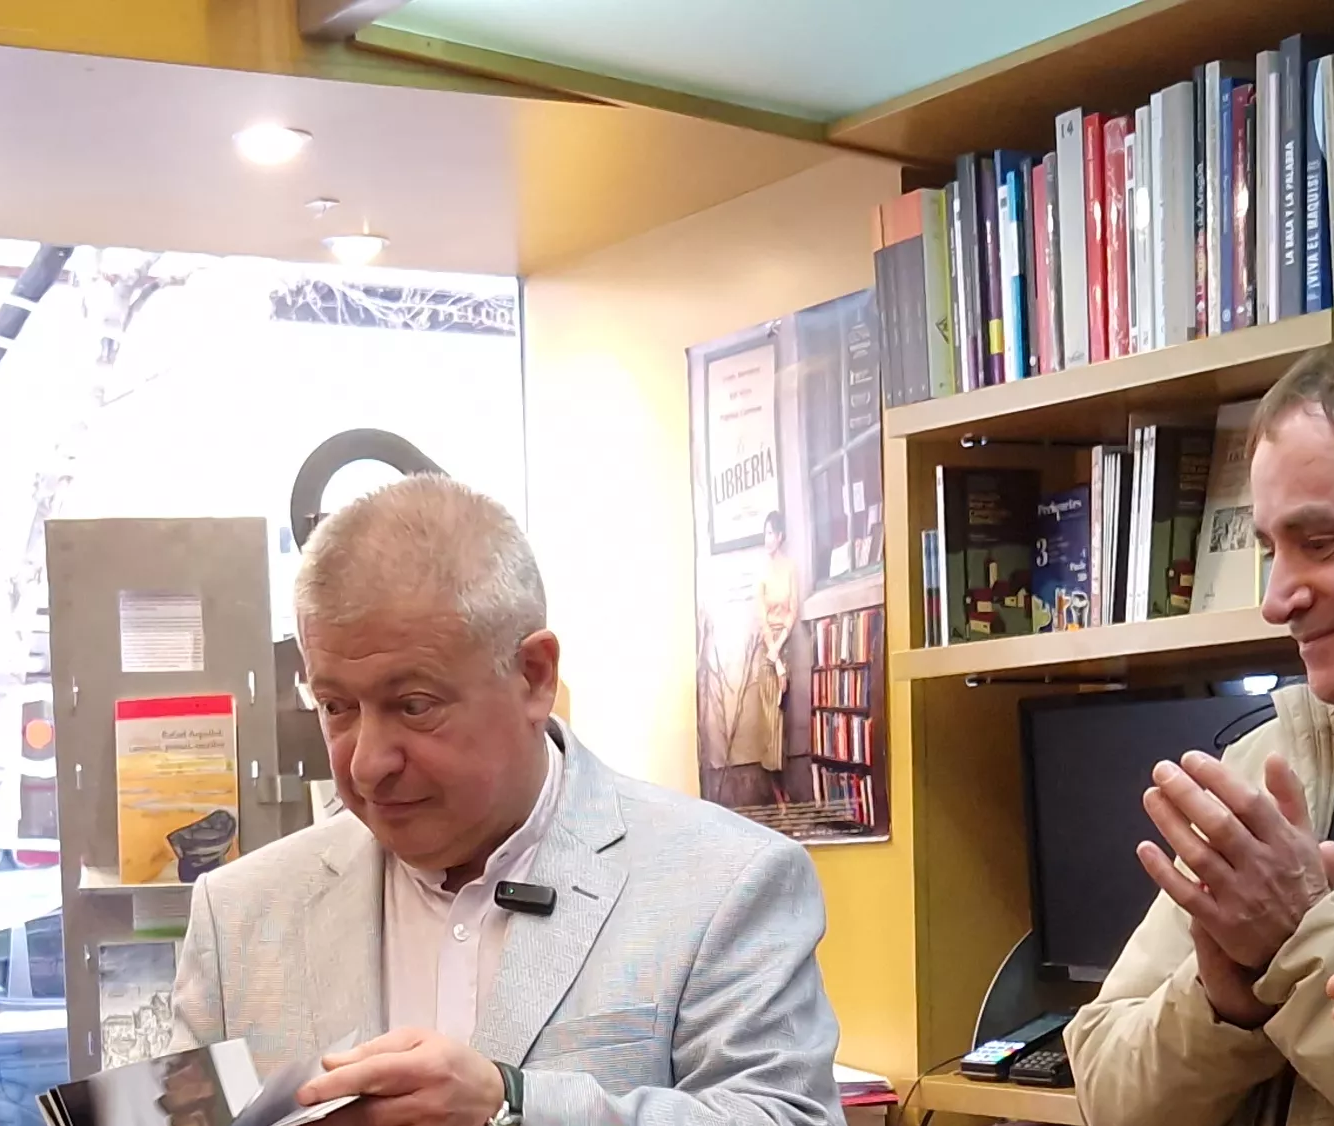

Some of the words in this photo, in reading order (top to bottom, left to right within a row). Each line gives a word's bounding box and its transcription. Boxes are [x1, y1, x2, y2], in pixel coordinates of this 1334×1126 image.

[1285, 140, 1295, 190] PALABRA
[1285, 192, 1295, 207] LA
[1285, 210, 1295, 218] Y
[1285, 219, 1295, 249] BALA
[1306, 232, 1319, 250] EL
[1285, 250, 1295, 265] LA
[714, 442, 775, 505] LIBRERÍA
[1036, 538, 1048, 567] 3
